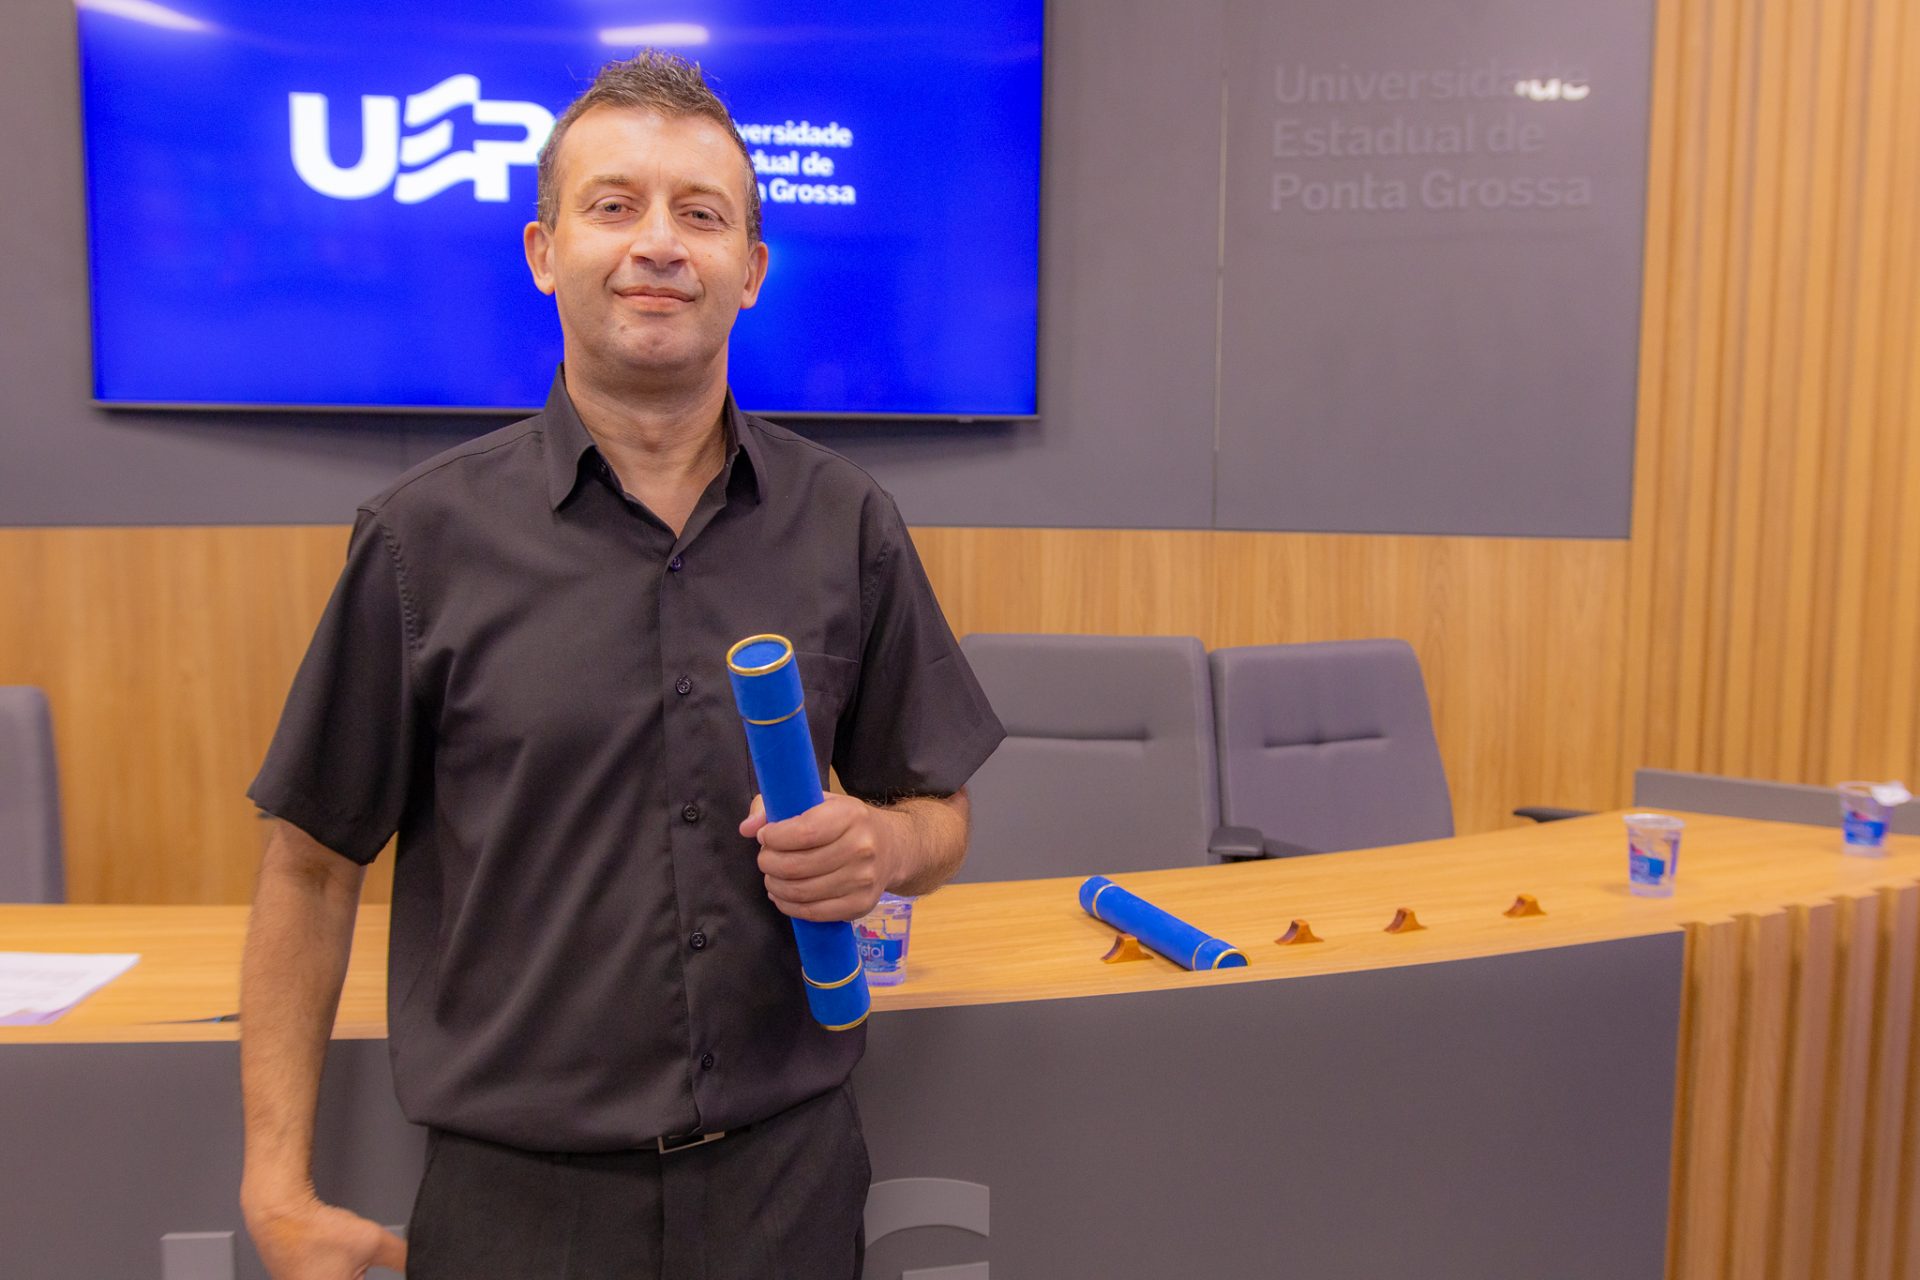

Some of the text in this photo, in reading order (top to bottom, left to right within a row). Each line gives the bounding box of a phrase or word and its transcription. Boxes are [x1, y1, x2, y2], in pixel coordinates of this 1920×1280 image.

[288, 73, 557, 204] UEP
[734, 119, 853, 148] versidade
[1273, 113, 1545, 157] Estadual de
[750, 149, 834, 177] dual de
[769, 177, 856, 205] Grossa
[1271, 168, 1592, 212] Ponta Grossa
